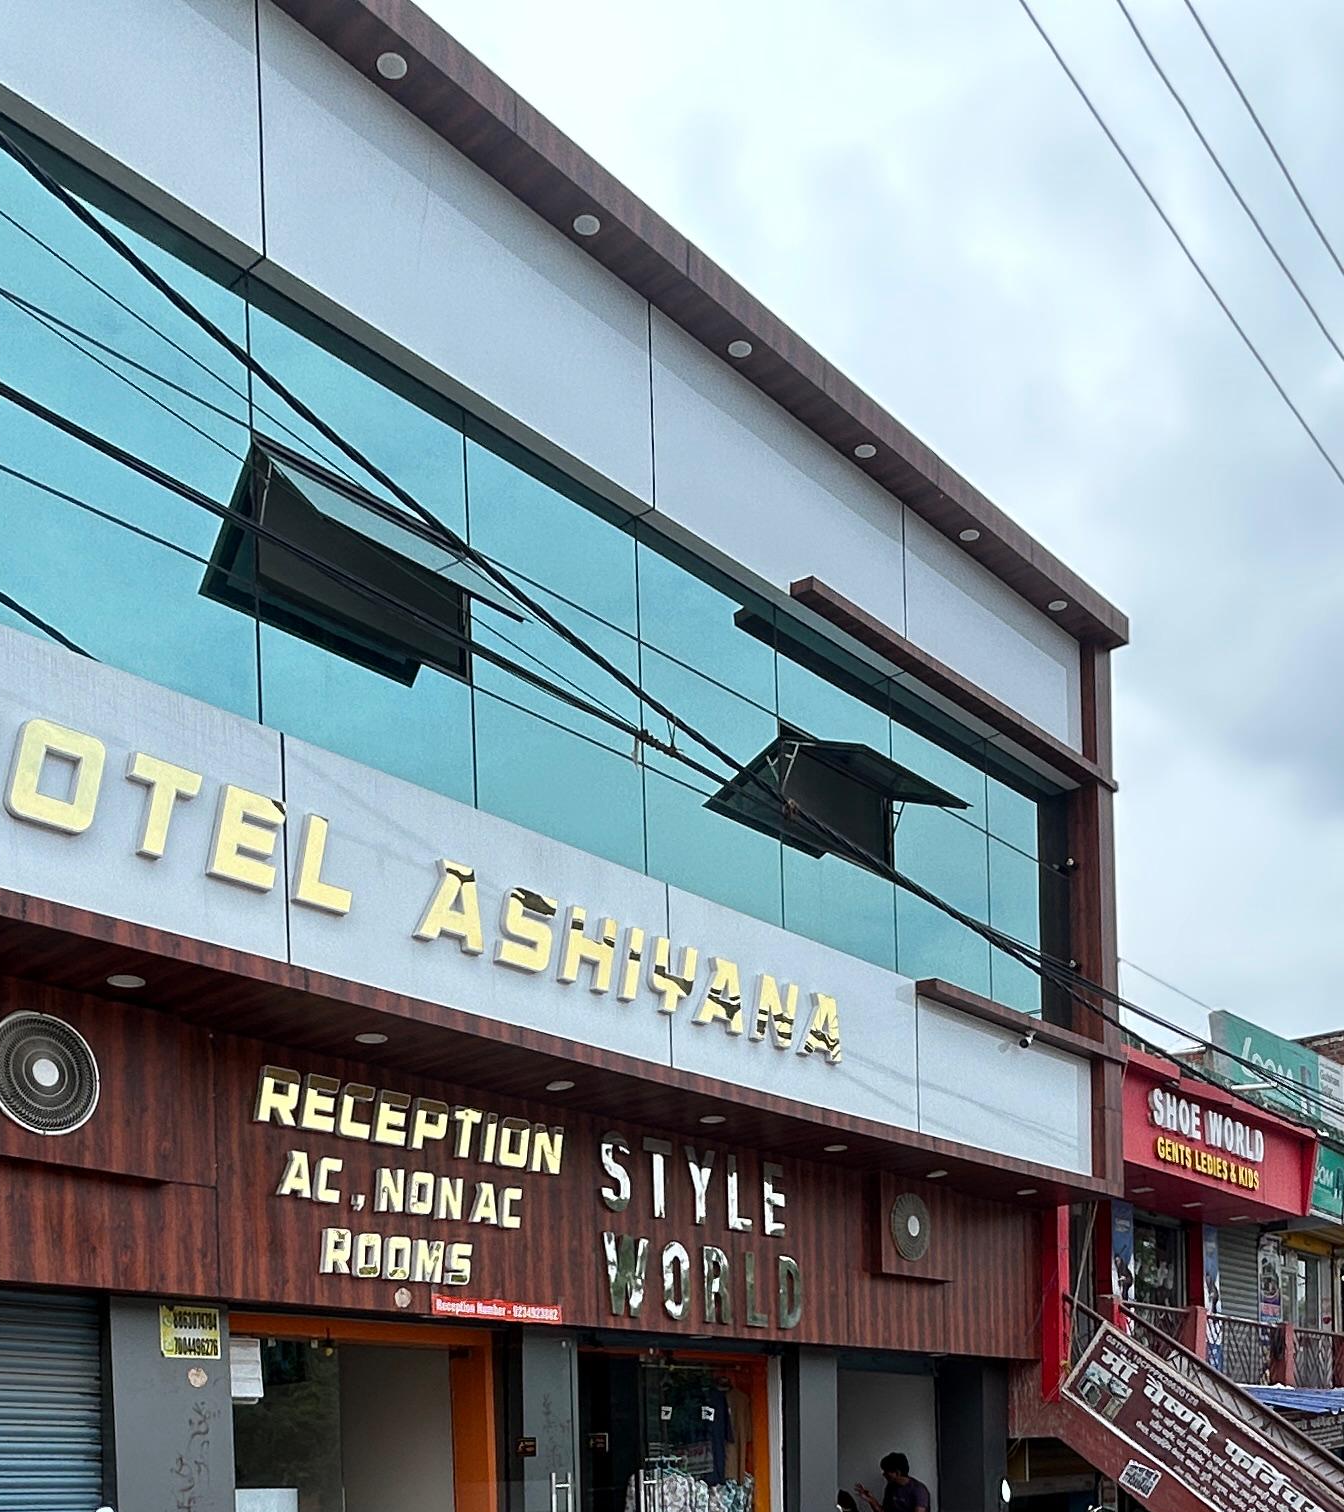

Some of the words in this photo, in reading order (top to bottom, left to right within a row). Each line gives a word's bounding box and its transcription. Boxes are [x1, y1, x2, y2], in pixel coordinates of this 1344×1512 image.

[412, 859, 843, 1064] ASHIYANA
[253, 1065, 565, 1175] RECEPTION
[1148, 1088, 1201, 1140] SHOE
[1204, 1110, 1264, 1162] WORLD
[375, 1167, 462, 1221] NON
[468, 1184, 523, 1229] AC
[600, 1130, 787, 1237] STYLE
[1156, 1136, 1192, 1169] GENTS
[1194, 1149, 1228, 1181] LEDIES
[1230, 1162, 1237, 1184] &
[1239, 1165, 1260, 1191] KIDS
[320, 1227, 474, 1286] ROOMS
[601, 1231, 803, 1330] WORLD
